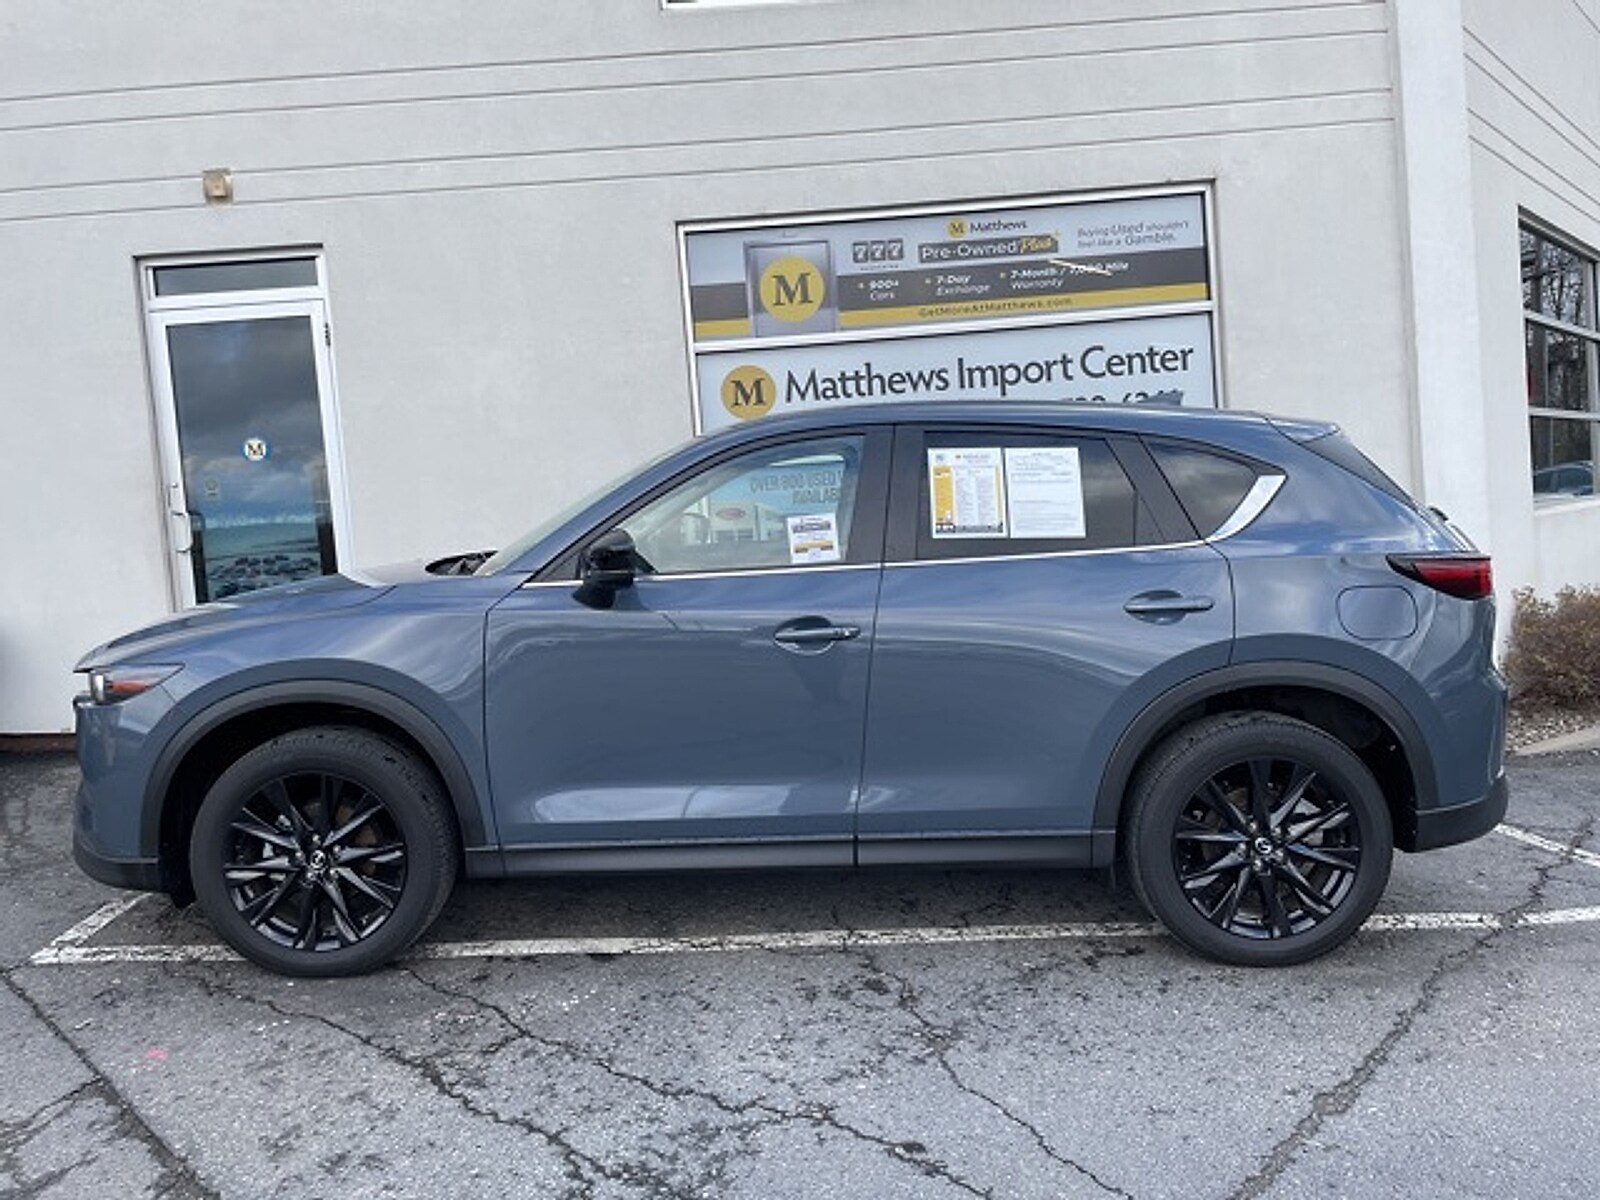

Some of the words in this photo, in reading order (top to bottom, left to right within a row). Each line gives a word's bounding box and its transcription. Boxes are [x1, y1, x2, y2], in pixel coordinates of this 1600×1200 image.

[970, 219, 1028, 232] Matthews
[1078, 227, 1110, 237] Buying
[1111, 222, 1144, 235] Used
[922, 240, 1017, 258] Pre-Owned
[772, 273, 814, 306] M
[937, 284, 990, 296] Exchange
[1010, 278, 1063, 289] Warranty
[870, 290, 895, 300] Cars
[918, 298, 1072, 317] GetMoreAtMatthews.com
[732, 378, 766, 406] M
[786, 362, 949, 402] Matthews
[958, 353, 1073, 396] Import
[1080, 345, 1194, 378] Center
